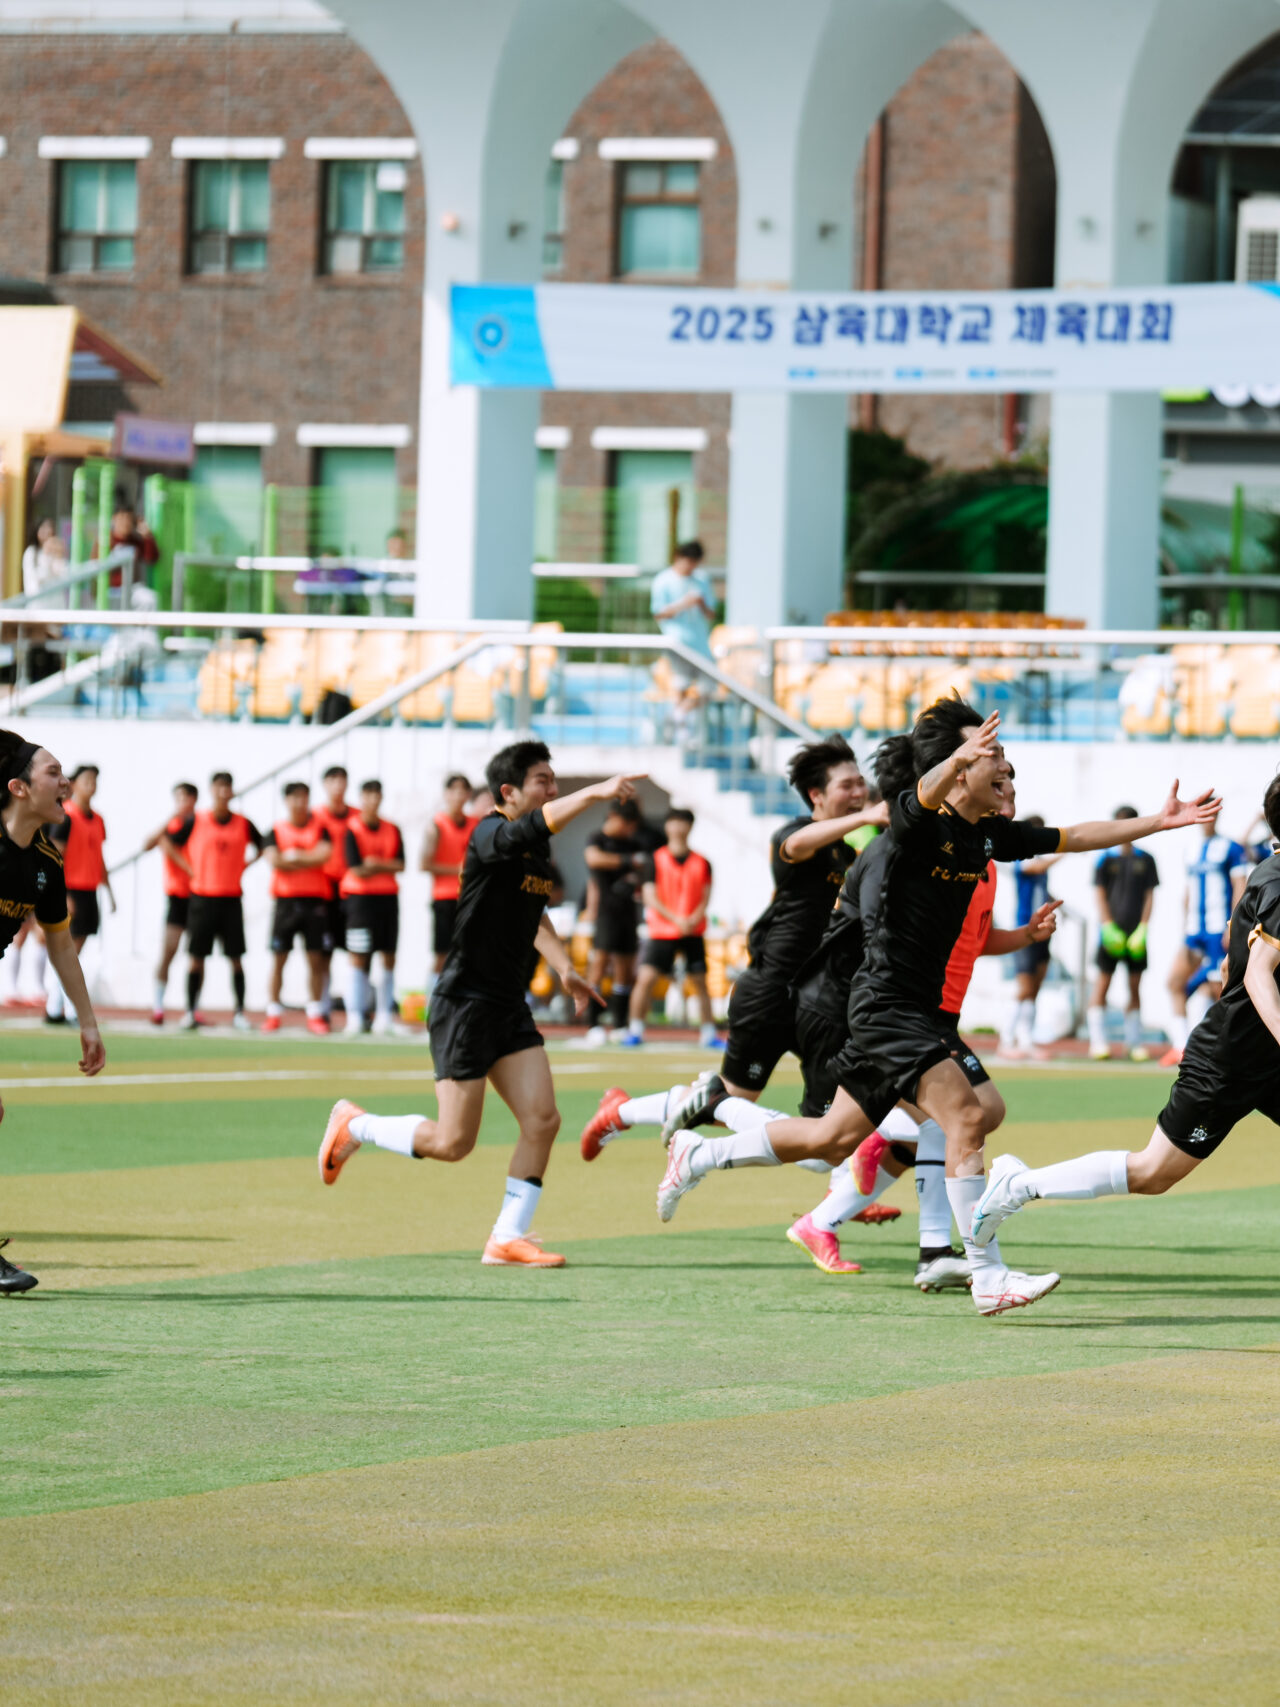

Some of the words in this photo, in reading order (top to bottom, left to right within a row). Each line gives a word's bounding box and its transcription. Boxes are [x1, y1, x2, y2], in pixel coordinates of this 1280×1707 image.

[670, 304, 774, 342] 2025
[794, 302, 992, 345] 삼육대학교
[1012, 301, 1174, 345] 체육대회
